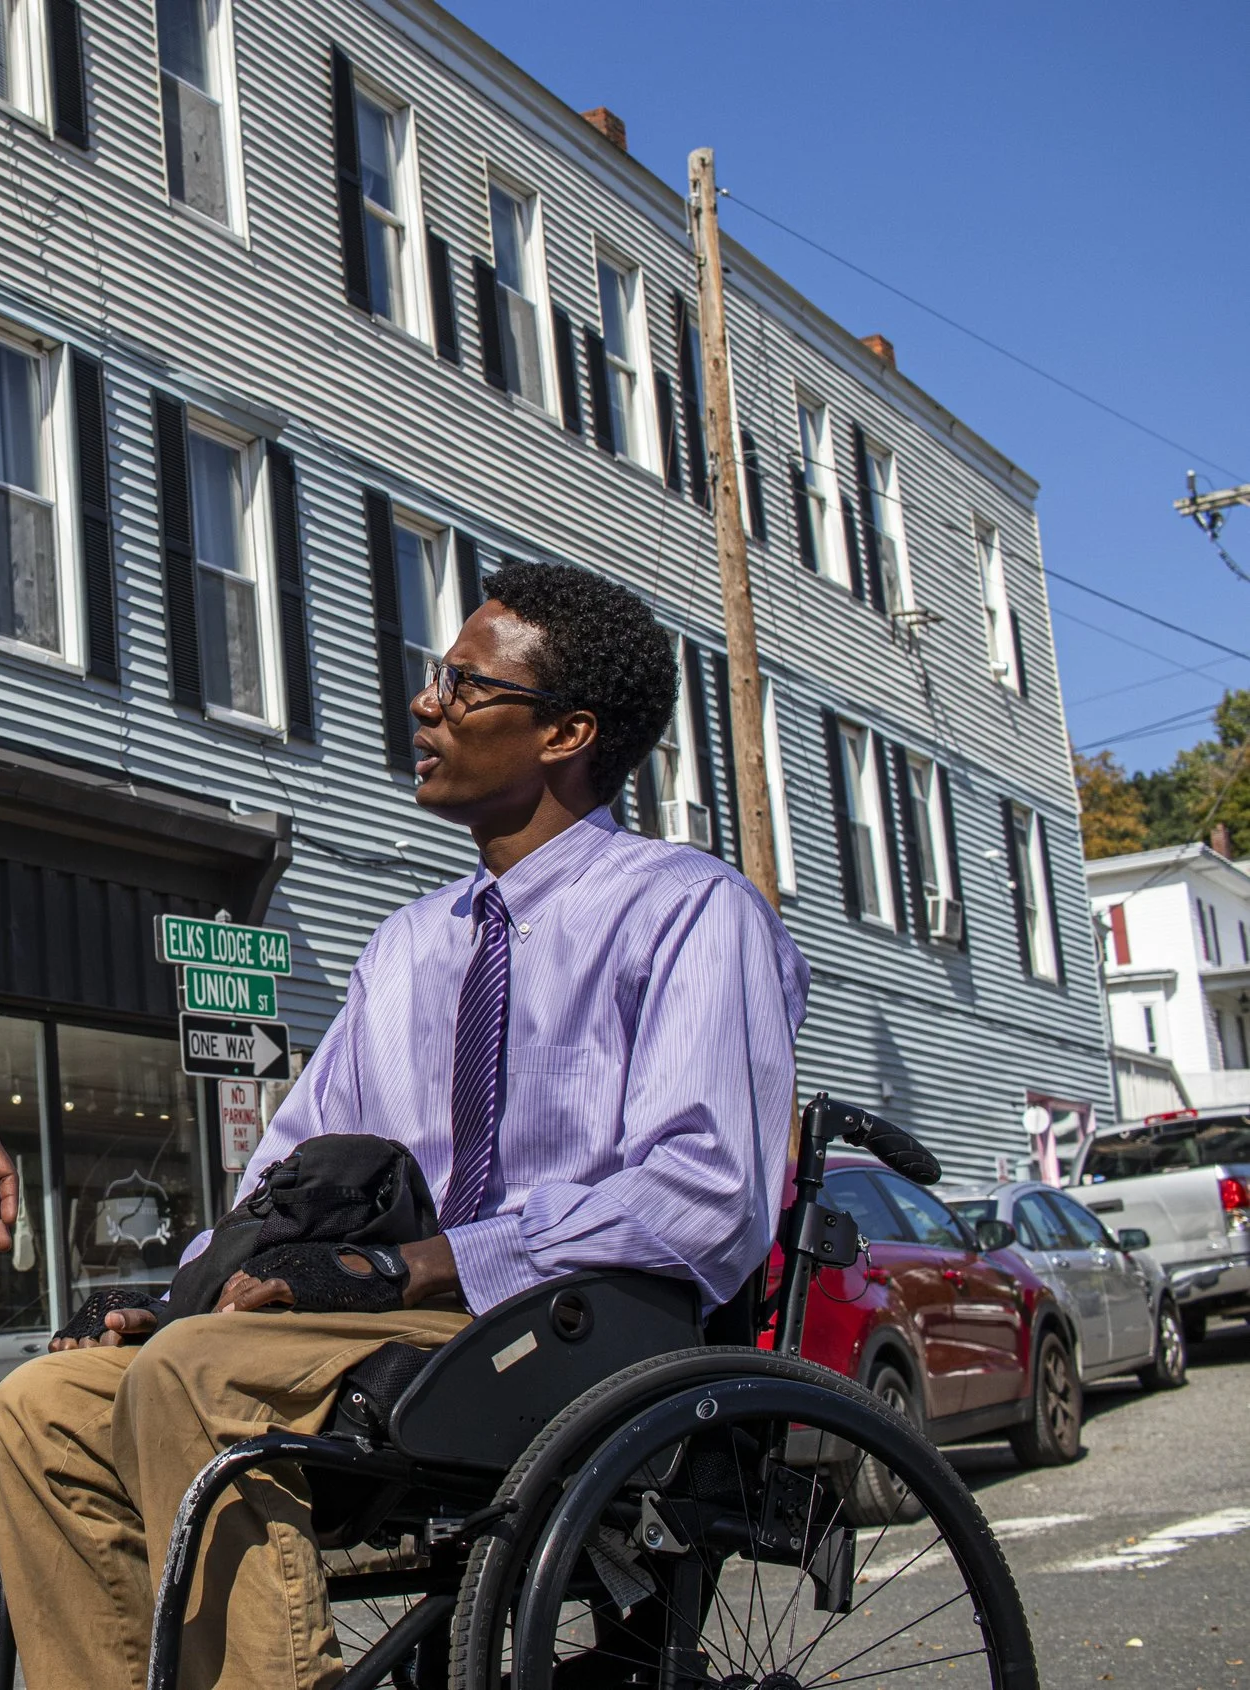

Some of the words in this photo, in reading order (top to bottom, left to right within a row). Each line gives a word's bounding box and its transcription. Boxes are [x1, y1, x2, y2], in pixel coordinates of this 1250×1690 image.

[169, 922, 205, 959] ELKS
[210, 927, 254, 965] LODGE
[259, 935, 286, 969] 844
[193, 972, 250, 1010] UNION
[258, 994, 268, 1011] ST
[191, 1033, 219, 1057] ONE
[226, 1036, 255, 1060] WAY
[231, 1088, 246, 1105] NO
[224, 1107, 256, 1125] PARKING
[233, 1127, 248, 1138] ANY
[234, 1140, 250, 1152] TIME
